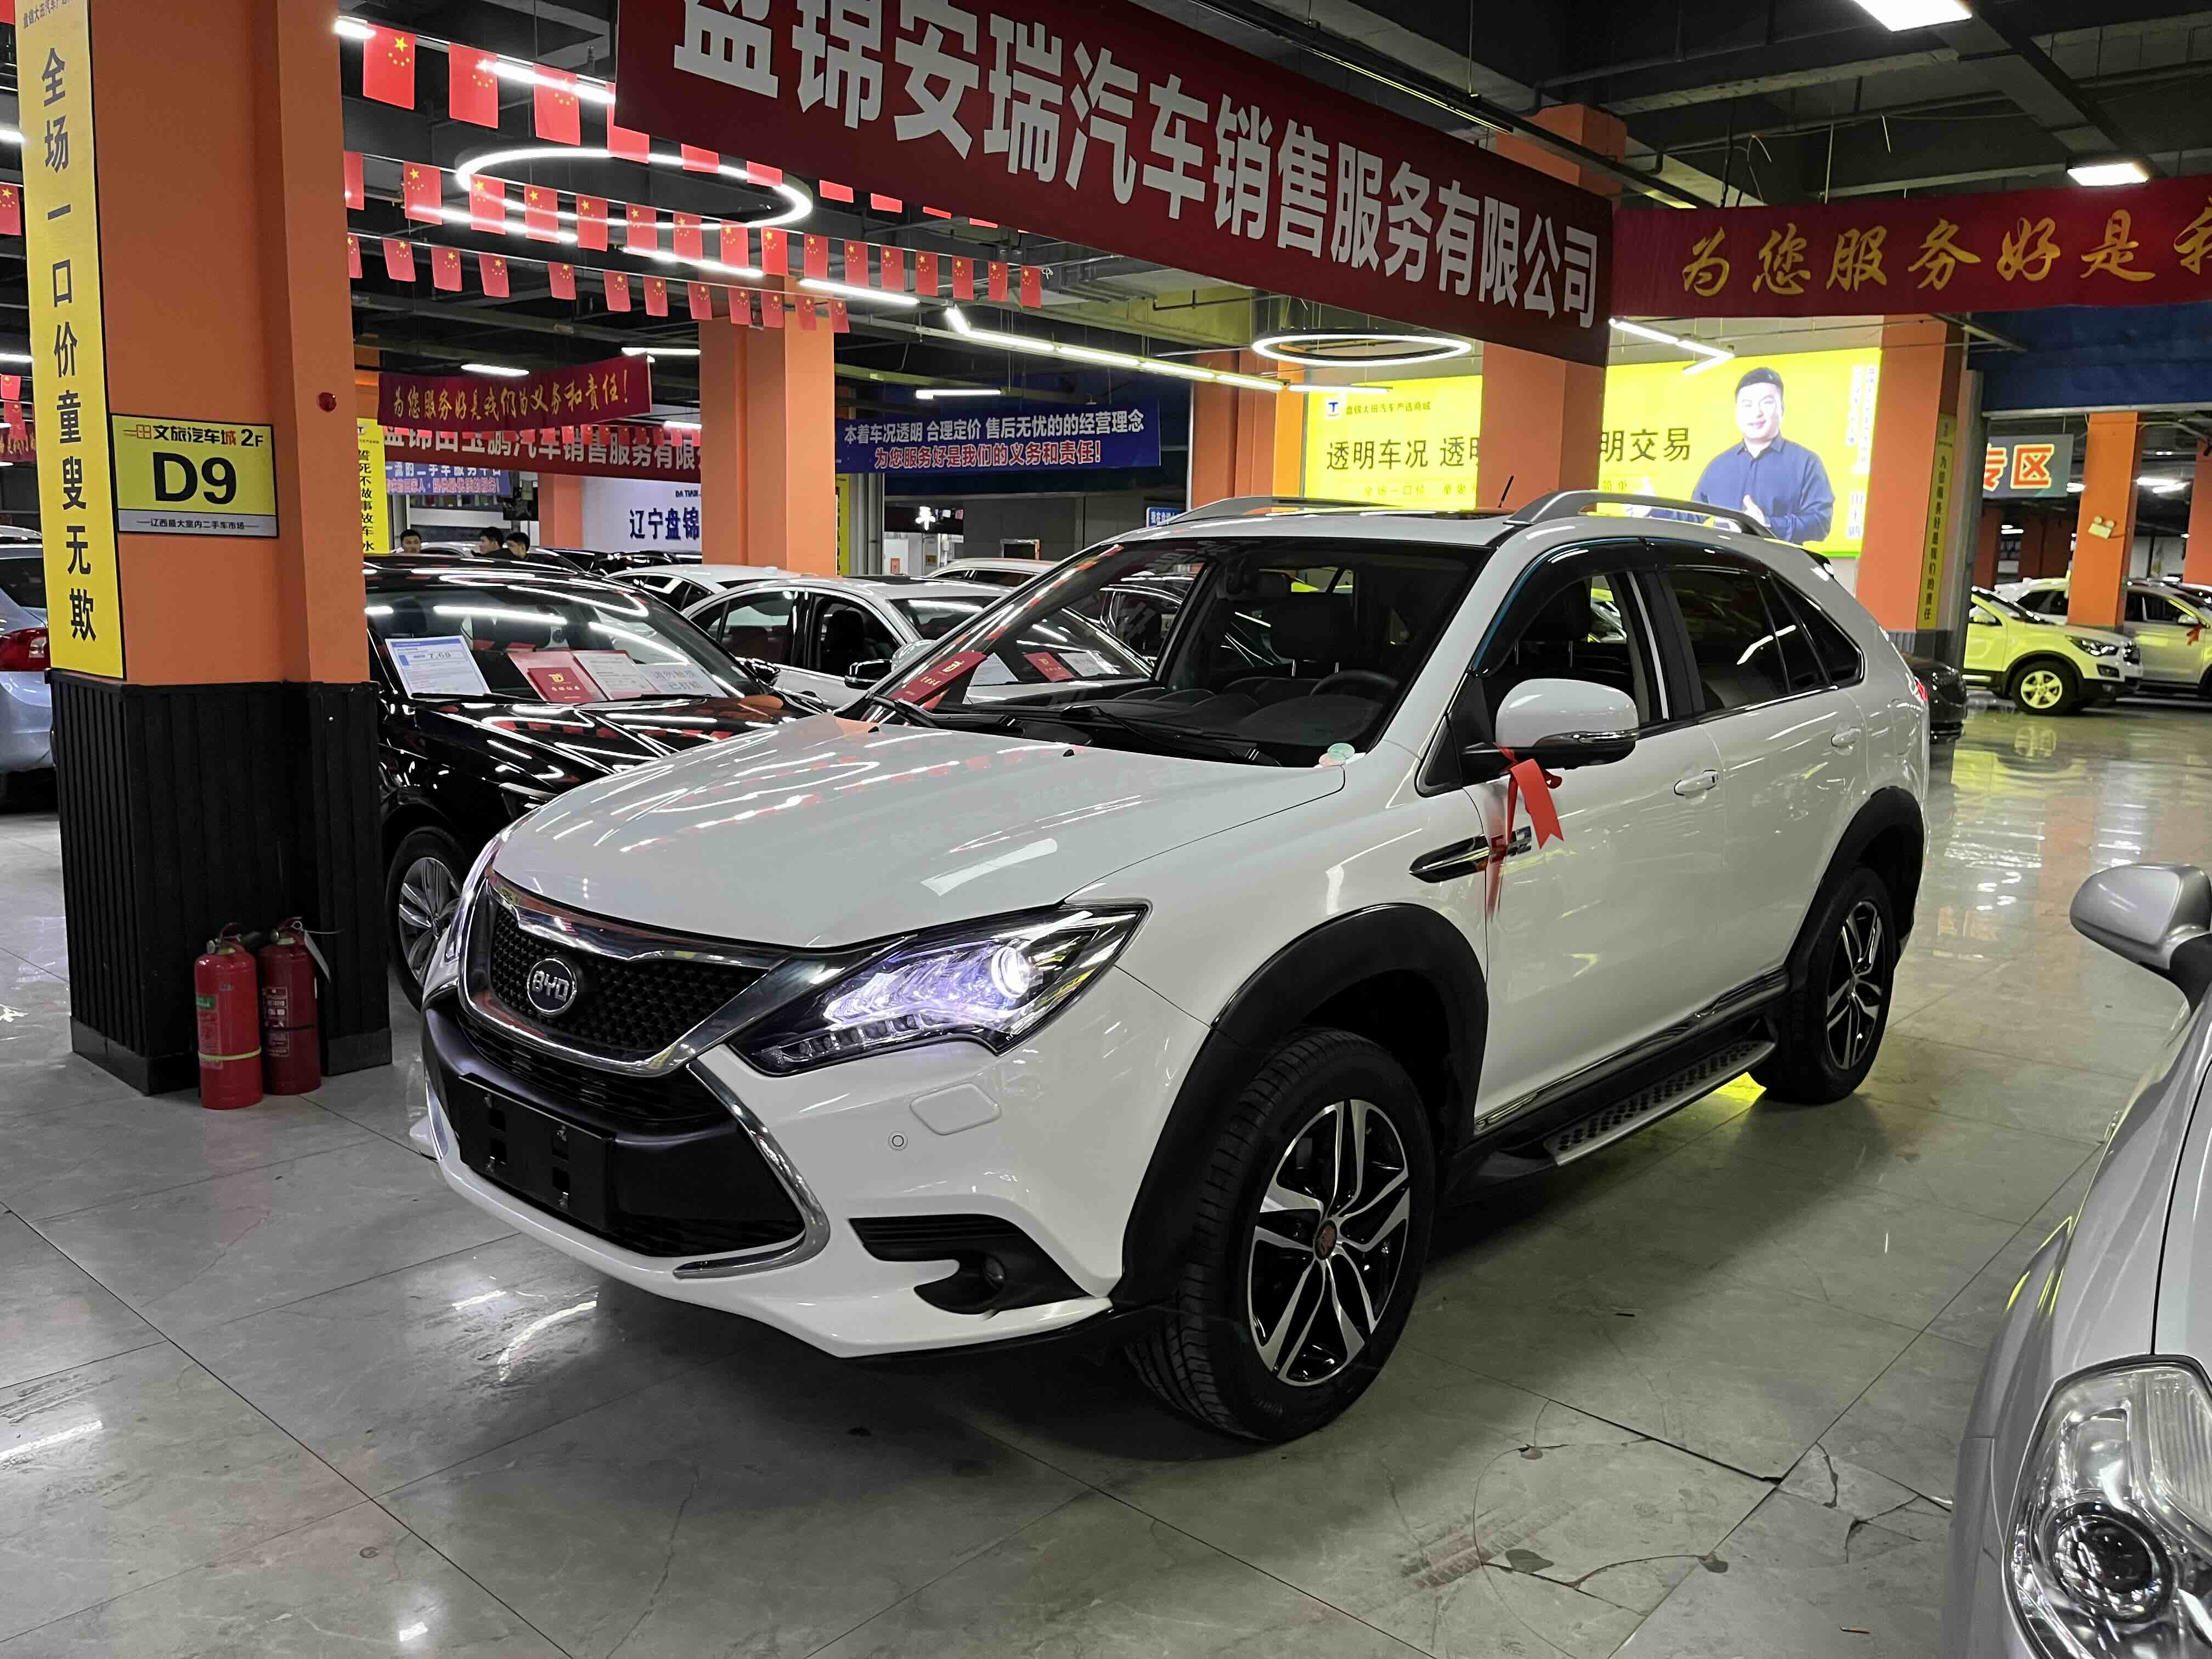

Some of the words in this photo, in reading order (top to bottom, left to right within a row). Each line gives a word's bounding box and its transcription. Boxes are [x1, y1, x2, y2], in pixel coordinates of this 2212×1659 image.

[674, 0, 1598, 329] 盘锦安瑞汽车销售服务有限公司
[153, 425, 236, 446] 文旅汽车城
[241, 429, 264, 447] 2F
[844, 421, 923, 445] 本着车况透明
[927, 420, 981, 441] 合理定价
[985, 409, 1144, 438] 售后无忧的的经营理念
[874, 440, 1102, 470] 为您服务好是我们的义务和责任!
[1327, 439, 1429, 470] 透明车况
[1599, 427, 1690, 462] 明交易
[153, 452, 237, 505] D9
[150, 517, 245, 531] 辽西最大室内二手车市场
[629, 506, 700, 540] 辽宁盘锦
[532, 970, 569, 1002] BYD
